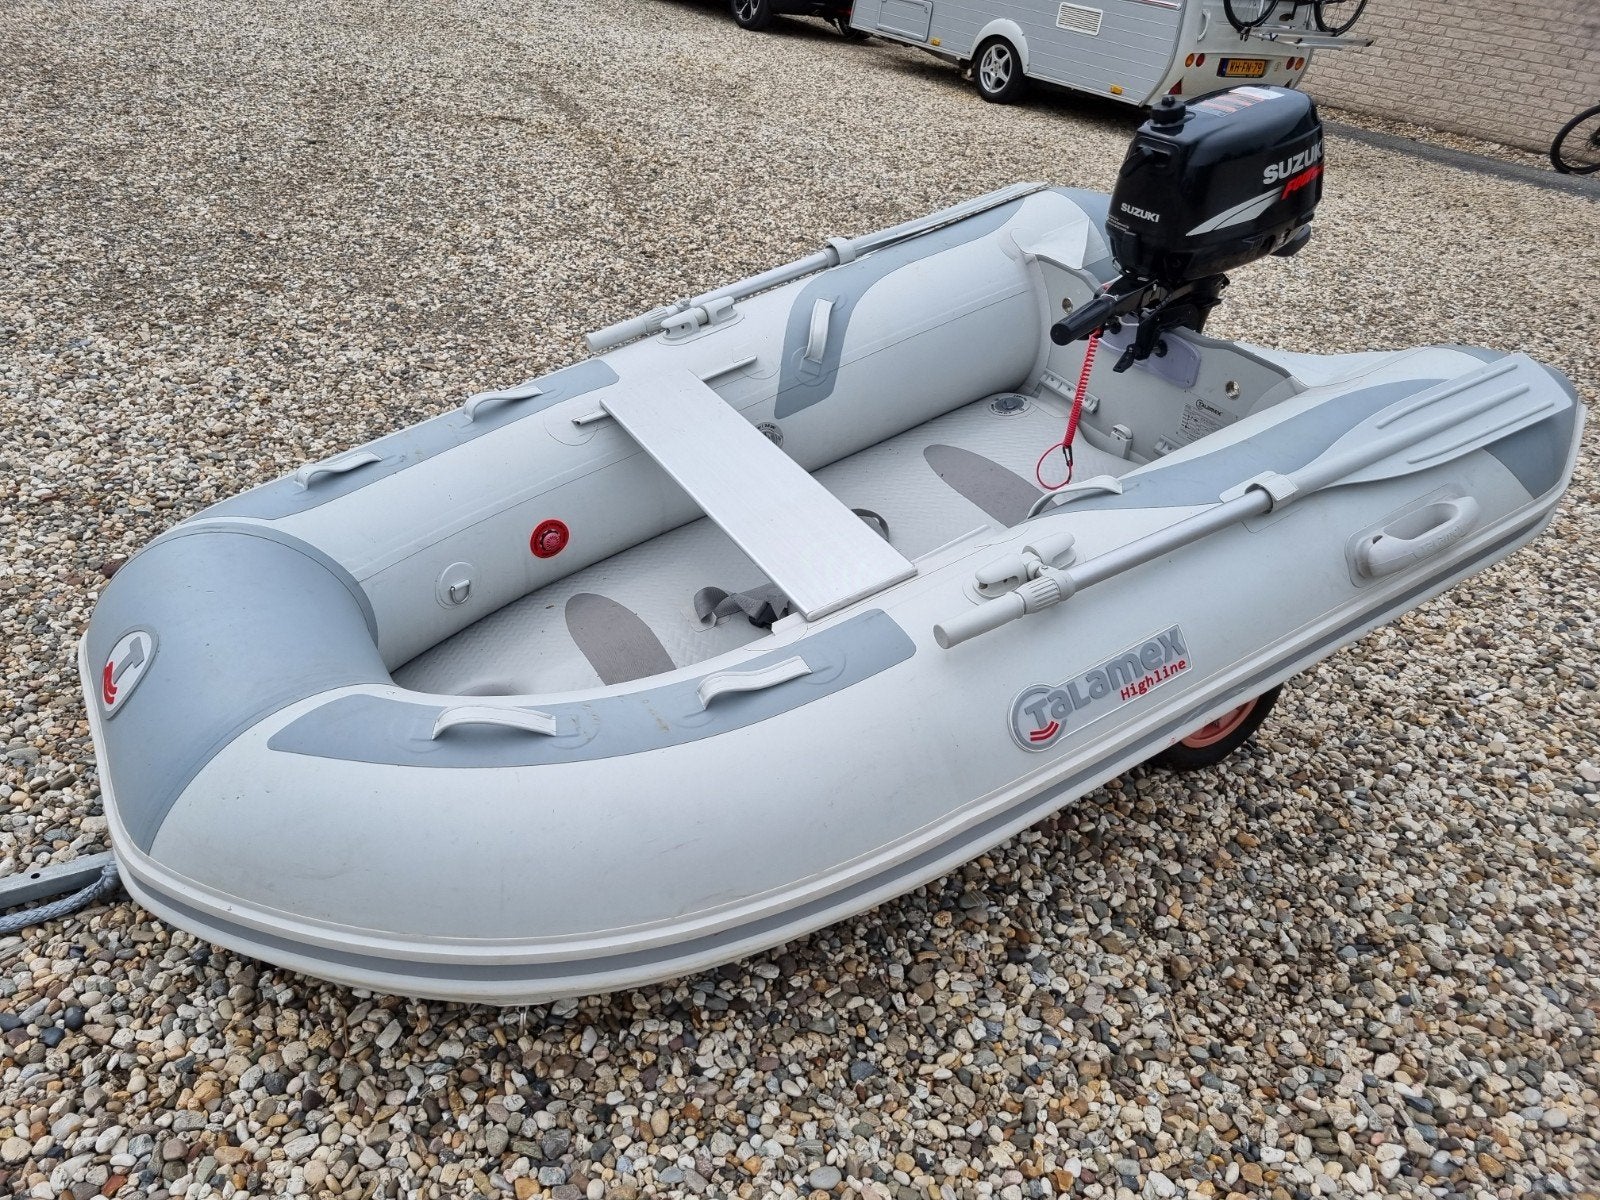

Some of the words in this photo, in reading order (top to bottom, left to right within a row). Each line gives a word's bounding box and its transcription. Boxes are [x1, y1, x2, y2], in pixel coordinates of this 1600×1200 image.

[1263, 140, 1323, 185] SUZUK
[1120, 202, 1160, 223] SUZUKI
[1120, 659, 1187, 701] Highline
